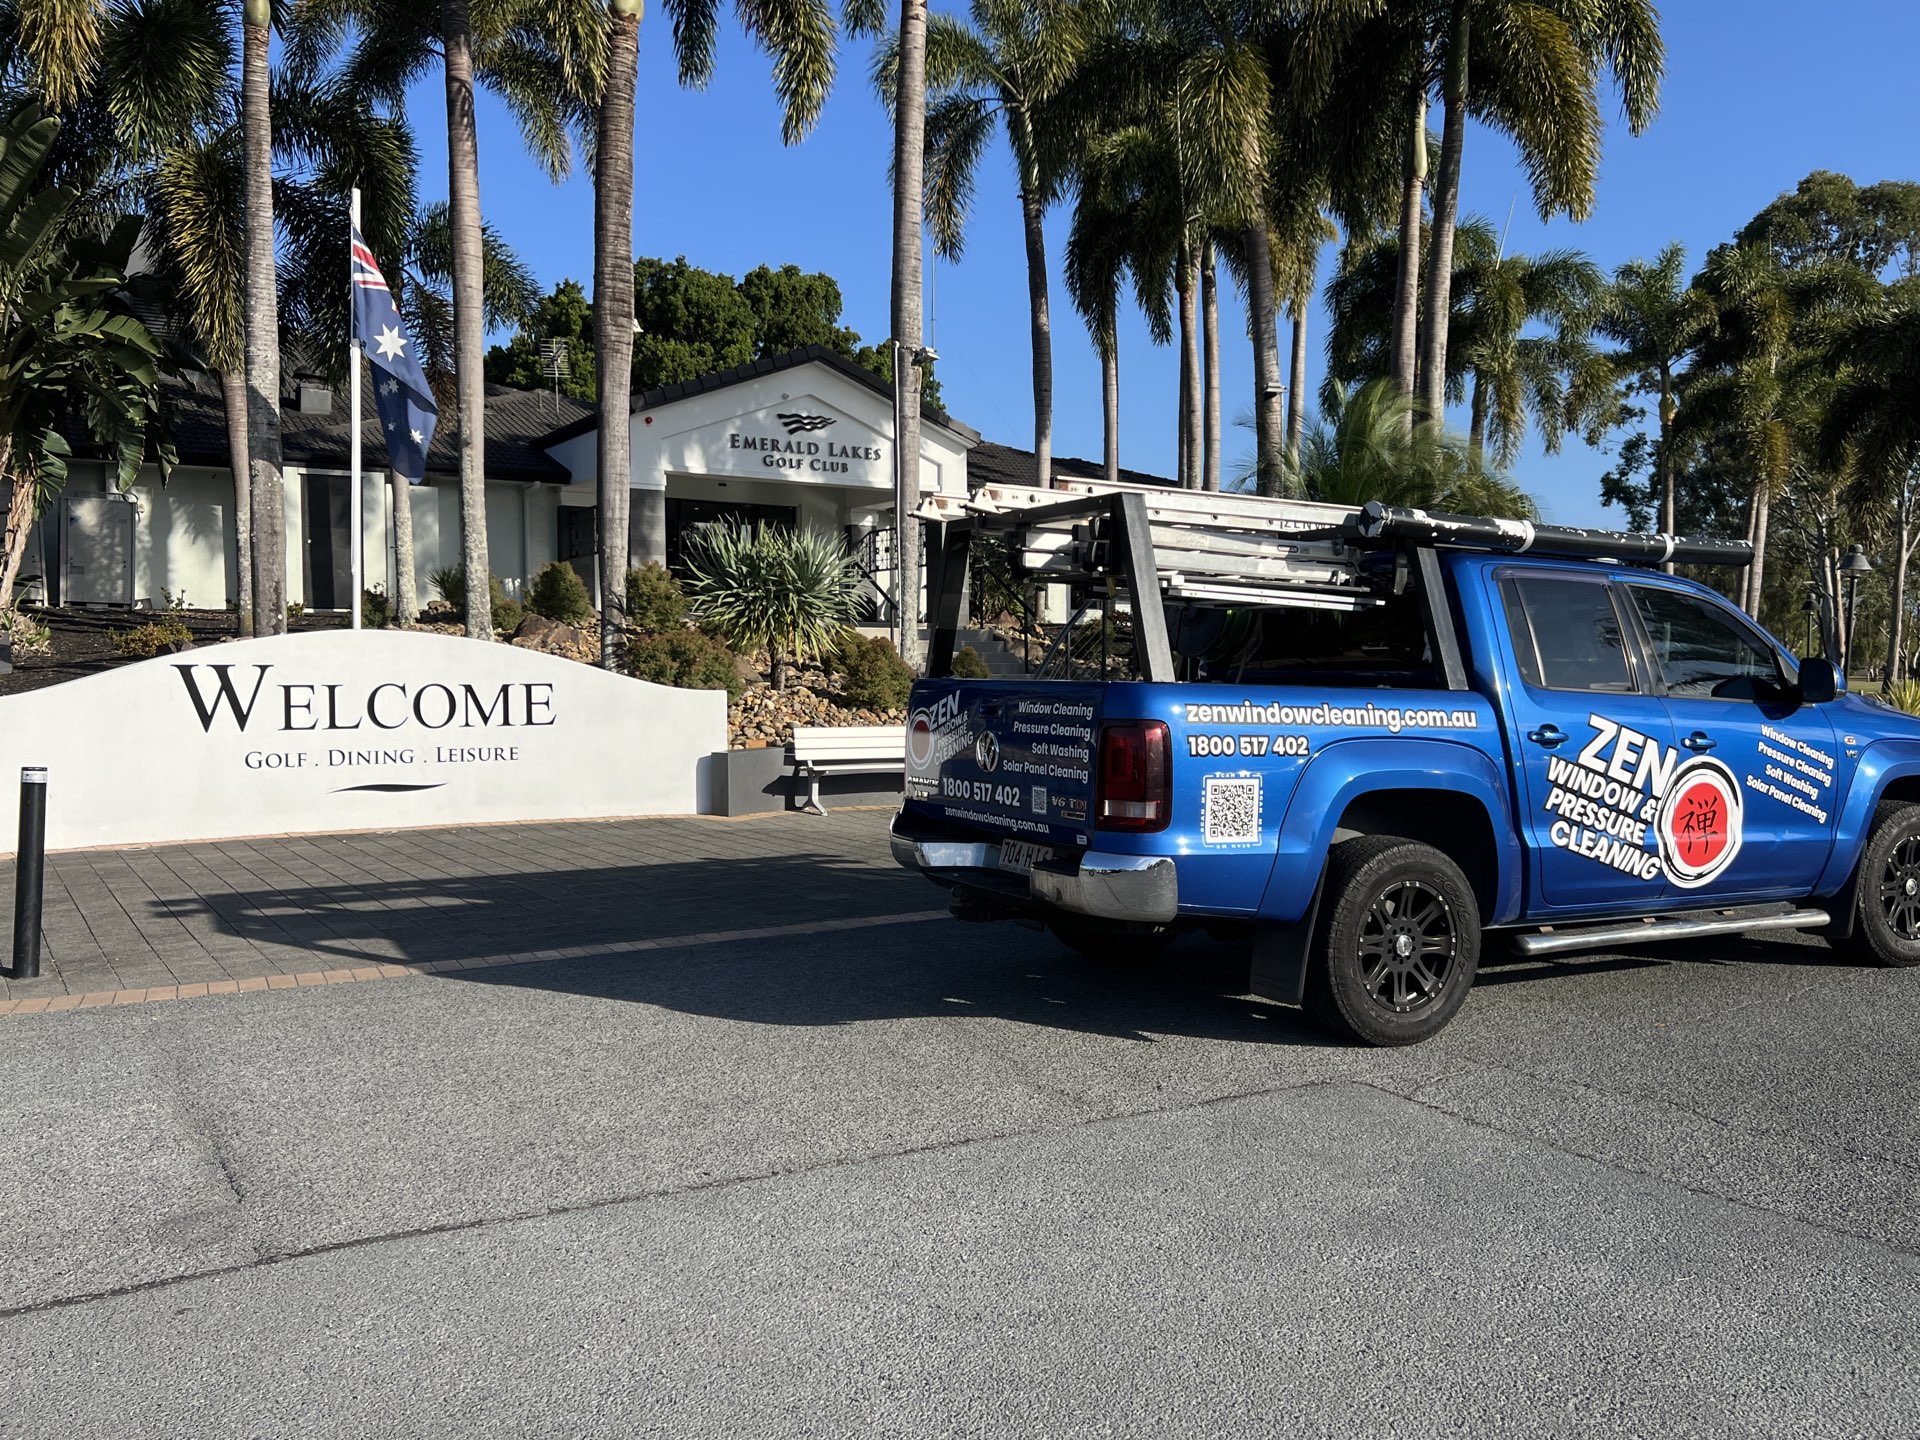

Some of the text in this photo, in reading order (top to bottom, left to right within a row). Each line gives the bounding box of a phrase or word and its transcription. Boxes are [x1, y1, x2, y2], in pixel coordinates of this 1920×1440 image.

[729, 433, 882, 461] EMERALD LAKES
[763, 454, 849, 473] GOLF CLUB
[170, 664, 557, 733] WELCOME
[929, 689, 960, 731] ZEN
[1018, 701, 1093, 720] Window Cleaning
[929, 712, 962, 741] WINDOW
[1013, 721, 1091, 741] Pressure Cleaning
[1186, 700, 1477, 733] zenwindowcleaning.com.au
[934, 731, 974, 766] CLEANING
[937, 721, 968, 750] PRESSURE
[1031, 742, 1089, 763] Soft Washing
[1188, 736, 1308, 756] 1800 517 402
[1761, 724, 1834, 770] Window Cleaning
[244, 751, 307, 769] GOLF
[328, 748, 415, 767] DINING
[436, 746, 519, 764] LEISURE
[1003, 759, 1089, 784] Solar Panel Cleaning
[1577, 713, 1679, 798] ZEN
[1758, 741, 1832, 788] Pressure Cleaning
[942, 777, 970, 799] 1800
[973, 781, 992, 802] 517
[995, 784, 1020, 807] 402
[1547, 756, 1660, 822] WINDOW &
[1746, 774, 1827, 824] Solar Panel Cleaning
[1765, 764, 1819, 800] Soft Washing
[944, 807, 1050, 834] zenwindowcleaning.com.au
[1544, 786, 1648, 846] PRESSURE
[1680, 794, 1719, 855] 禅
[1550, 820, 1661, 880] CLEANING
[1433, 872, 1471, 923] TOYO
